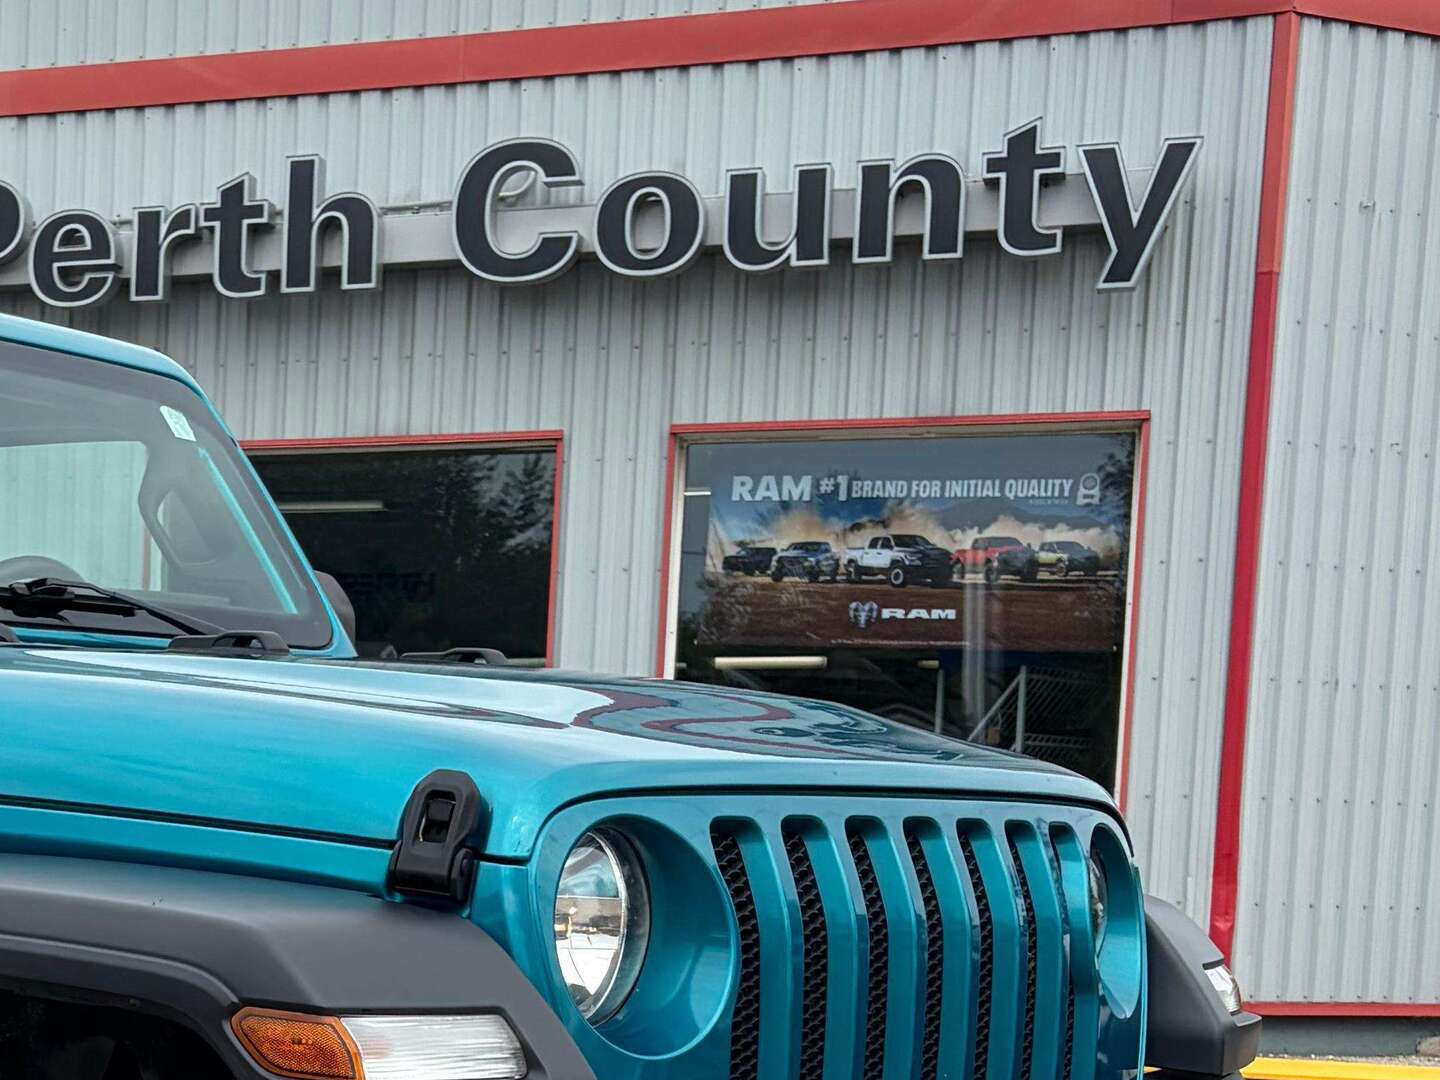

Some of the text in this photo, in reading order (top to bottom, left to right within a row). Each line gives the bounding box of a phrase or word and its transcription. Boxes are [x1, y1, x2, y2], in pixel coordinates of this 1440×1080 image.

[455, 116, 1204, 293] County
[731, 475, 1074, 501] RAM #1 BRAND FOR INITIAL QUALITY
[880, 607, 957, 620] RAM
